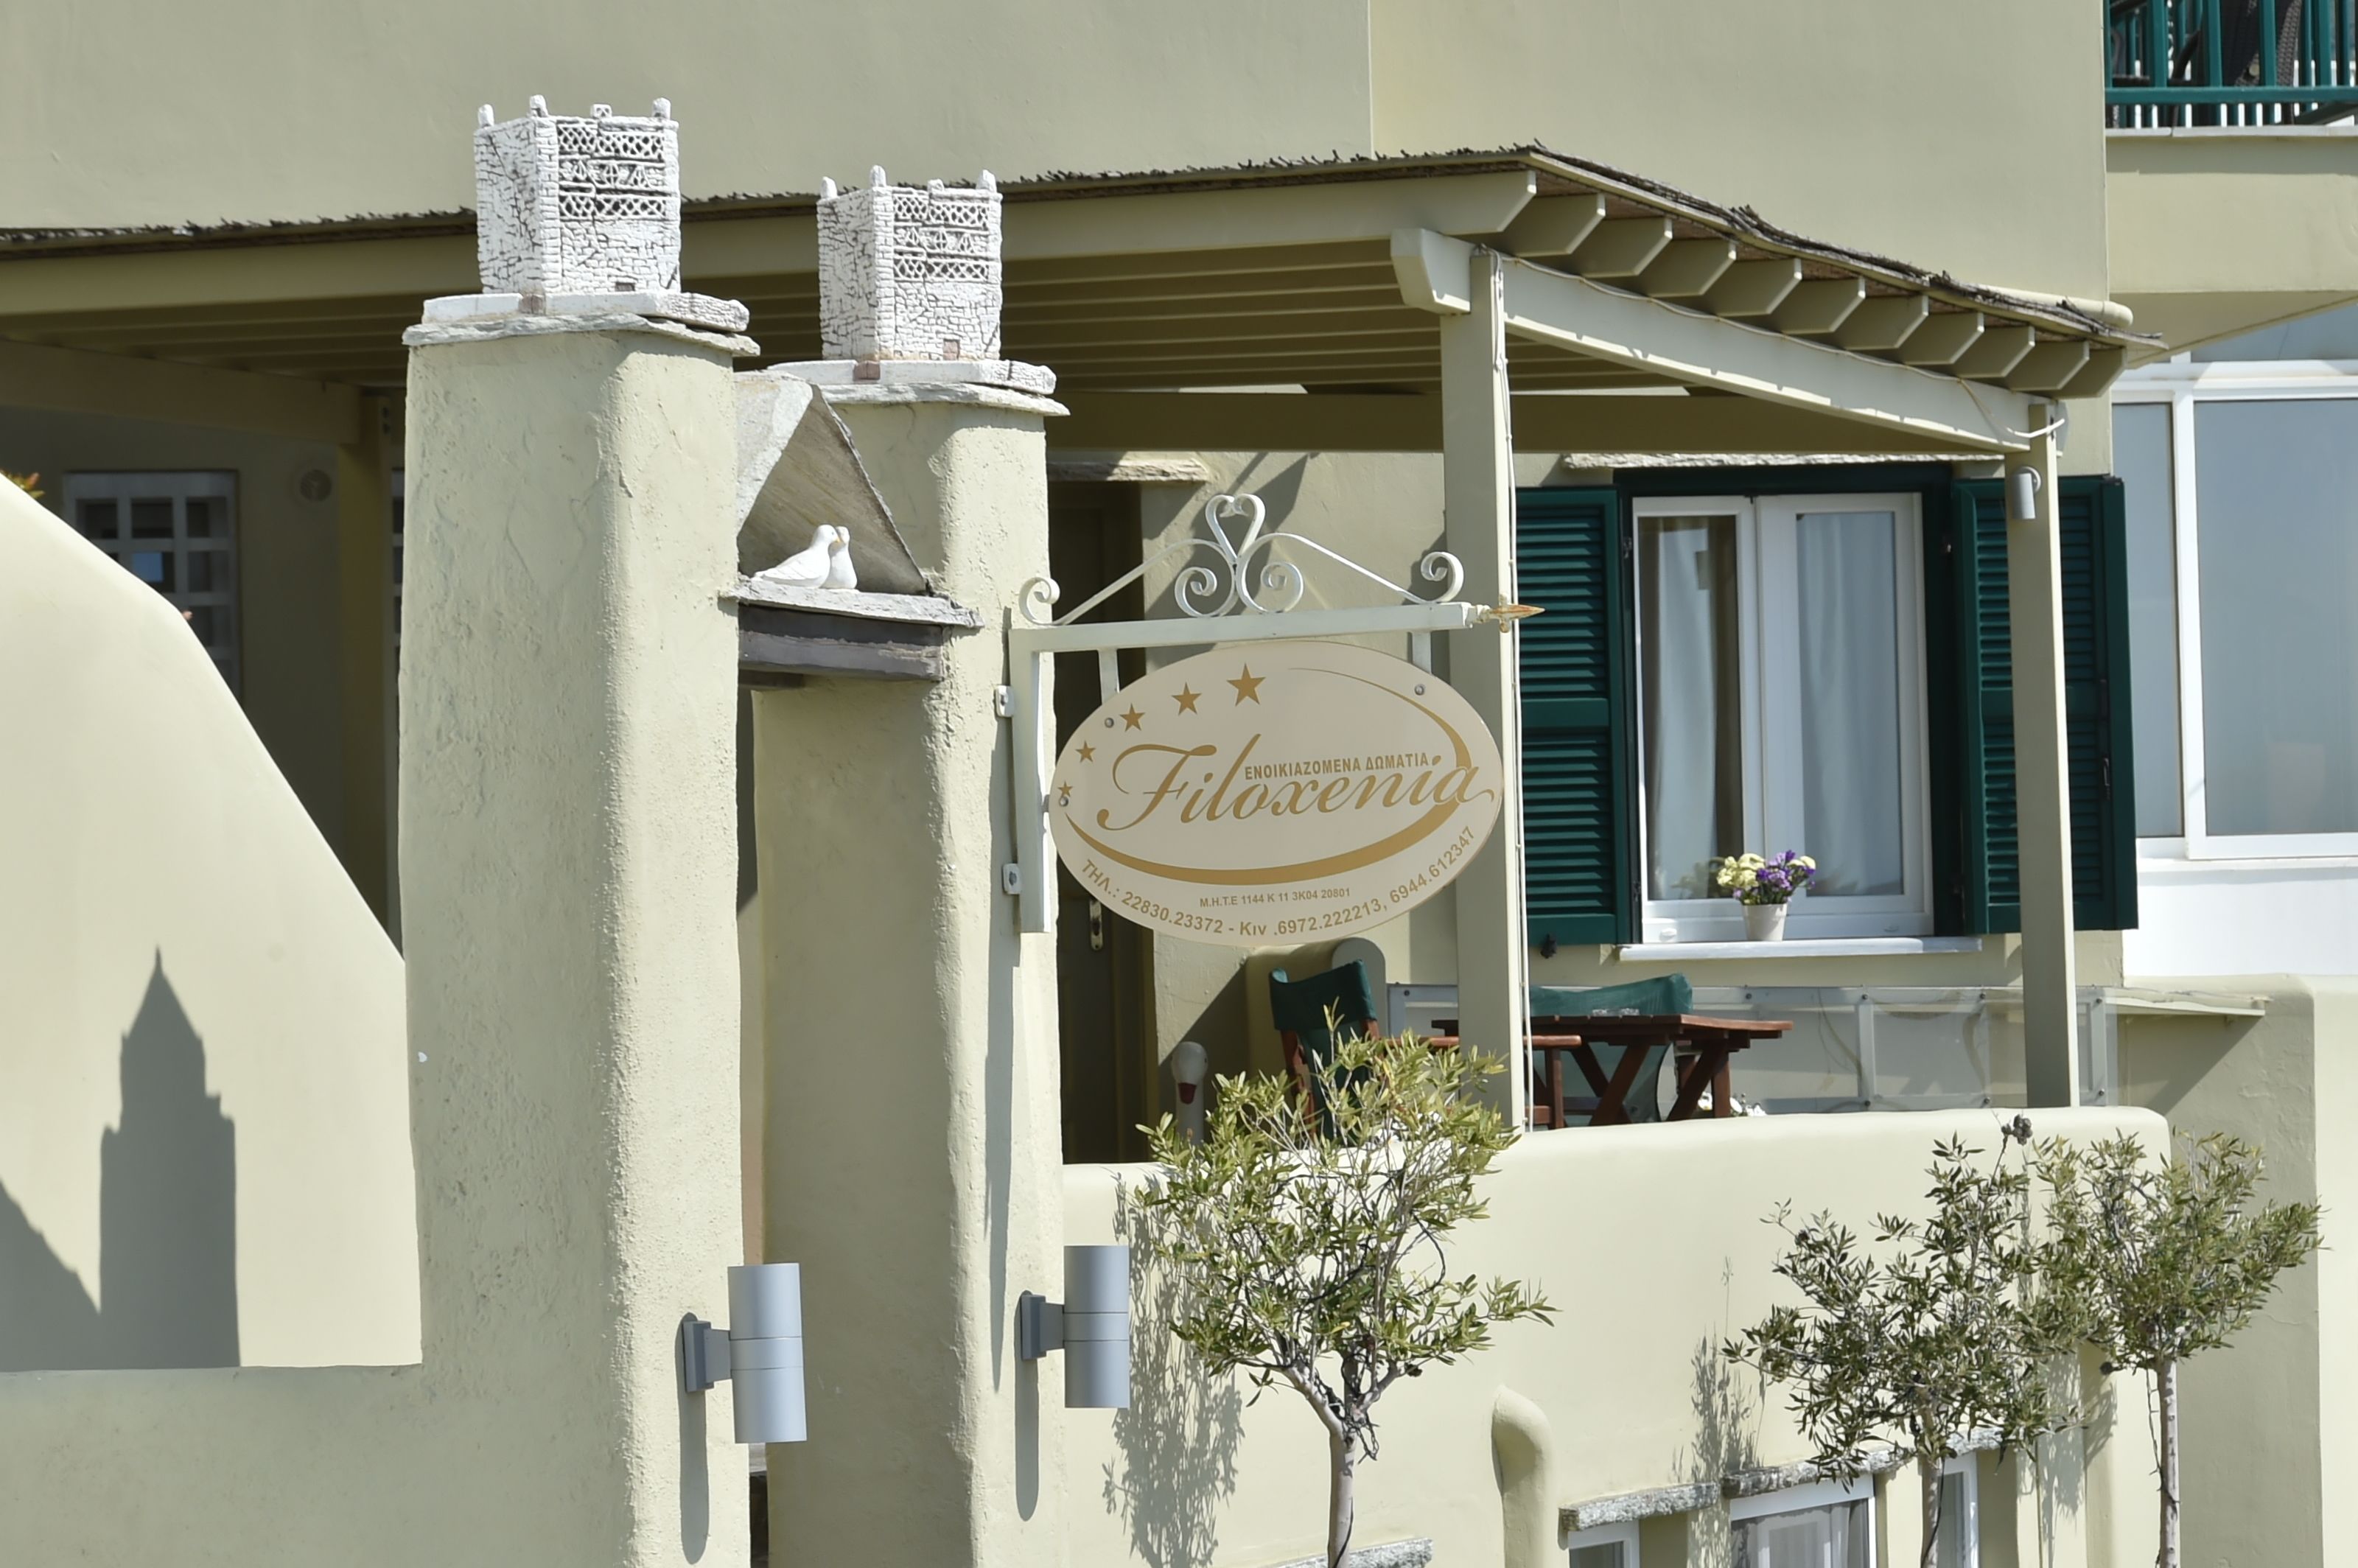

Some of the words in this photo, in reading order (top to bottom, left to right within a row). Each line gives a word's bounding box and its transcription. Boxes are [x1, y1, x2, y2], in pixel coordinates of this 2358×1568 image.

[1096, 733, 1494, 831] Filoxenia
[1245, 757, 1362, 780] ΕΝΟΙΚΙΑΖΟΜΕΝΑ
[1365, 752, 1429, 771] ΔΩΜΑΤΙΑ
[1122, 892, 1222, 934] 22830.23372
[1390, 826, 1474, 903] 6944.612347
[1242, 894, 1264, 904] 1144
